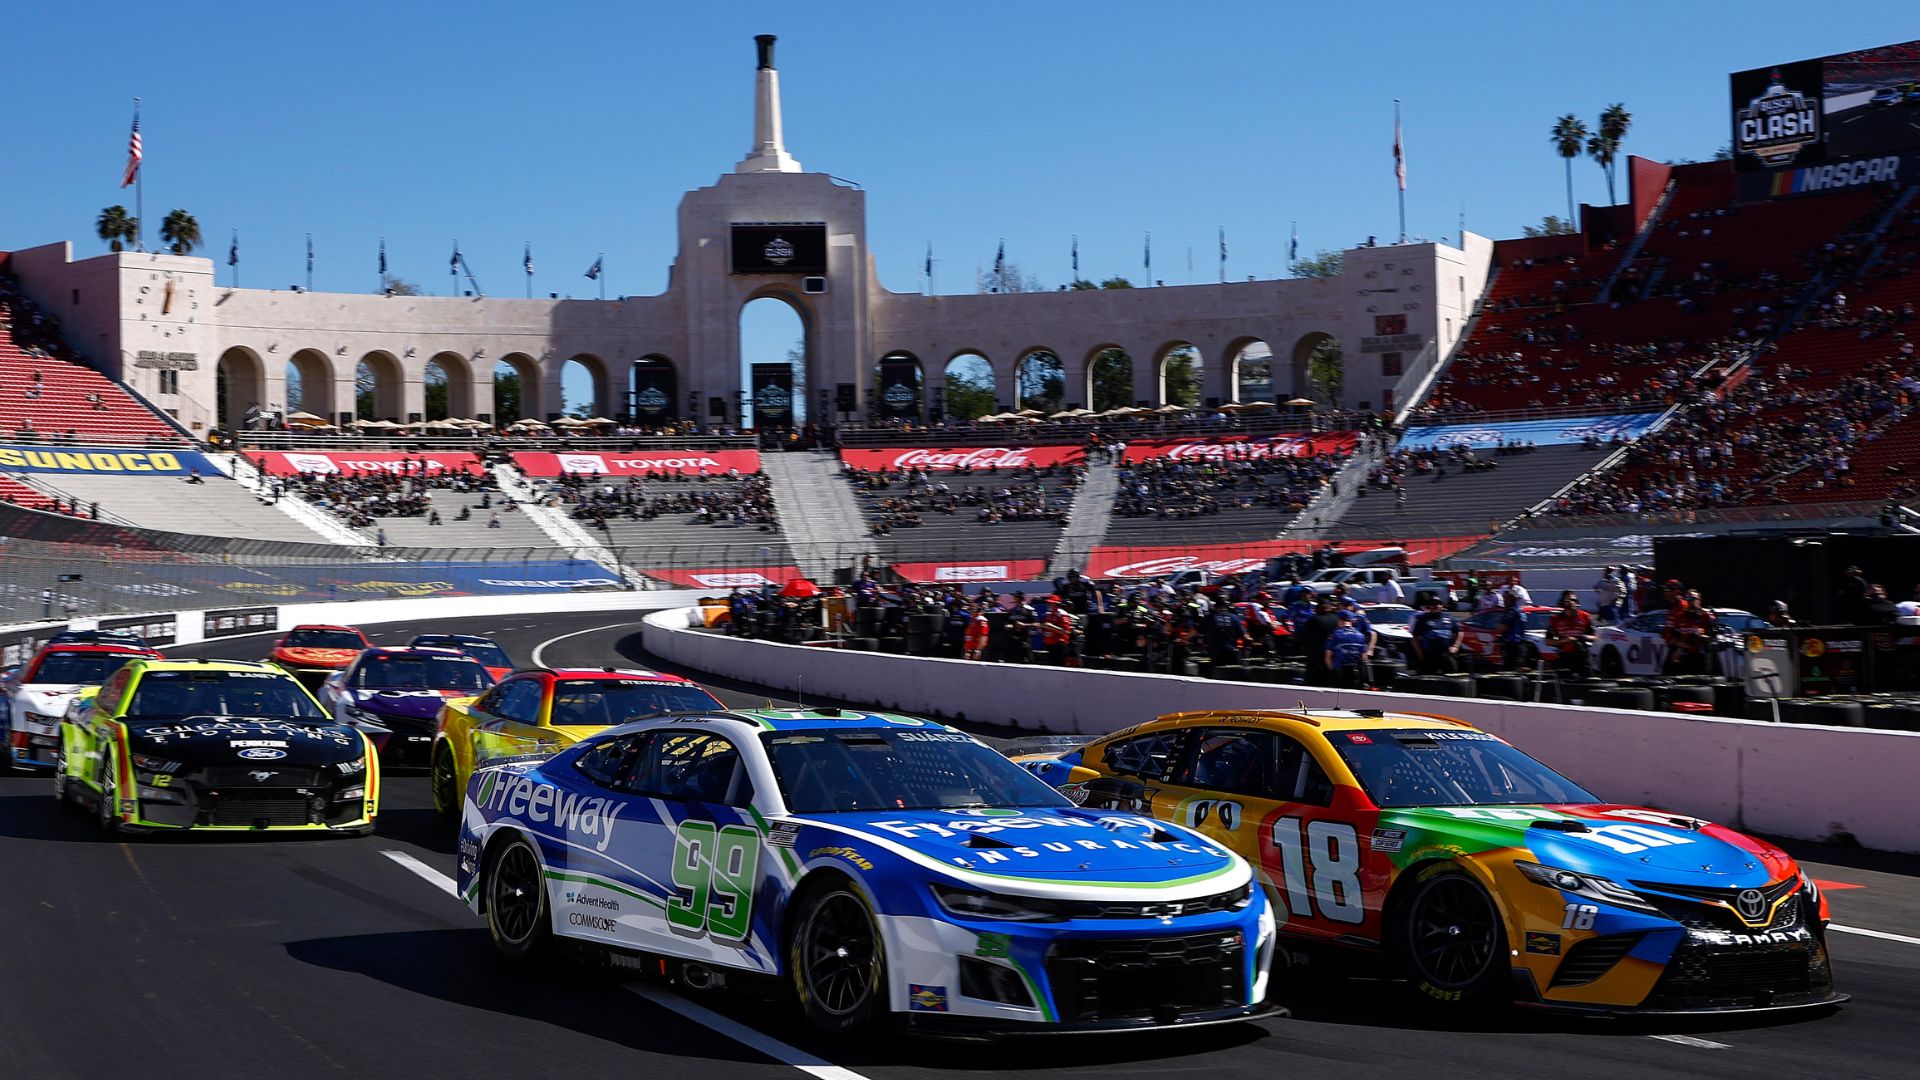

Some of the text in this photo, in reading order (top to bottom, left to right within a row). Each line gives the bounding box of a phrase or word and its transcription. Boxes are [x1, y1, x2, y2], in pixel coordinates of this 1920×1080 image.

[1741, 110, 1816, 142] CLASH
[1801, 155, 1900, 192] NASCAR
[0, 449, 183, 471] SUNOCO
[611, 457, 720, 469] TOYOTA
[894, 448, 1034, 468] Coca-Cola
[230, 740, 289, 749] PENNZOIL
[897, 731, 974, 743] SUÁREZ
[1423, 732, 1461, 740] KYLE
[151, 774, 173, 787] 12
[489, 770, 628, 852] Freeway
[867, 817, 1167, 838] Freeway
[952, 839, 1229, 869] INSURANCE
[667, 820, 763, 943] 99
[1272, 816, 1366, 926] 18
[569, 912, 617, 933] COMMSCOPE
[1561, 903, 1599, 930] 18
